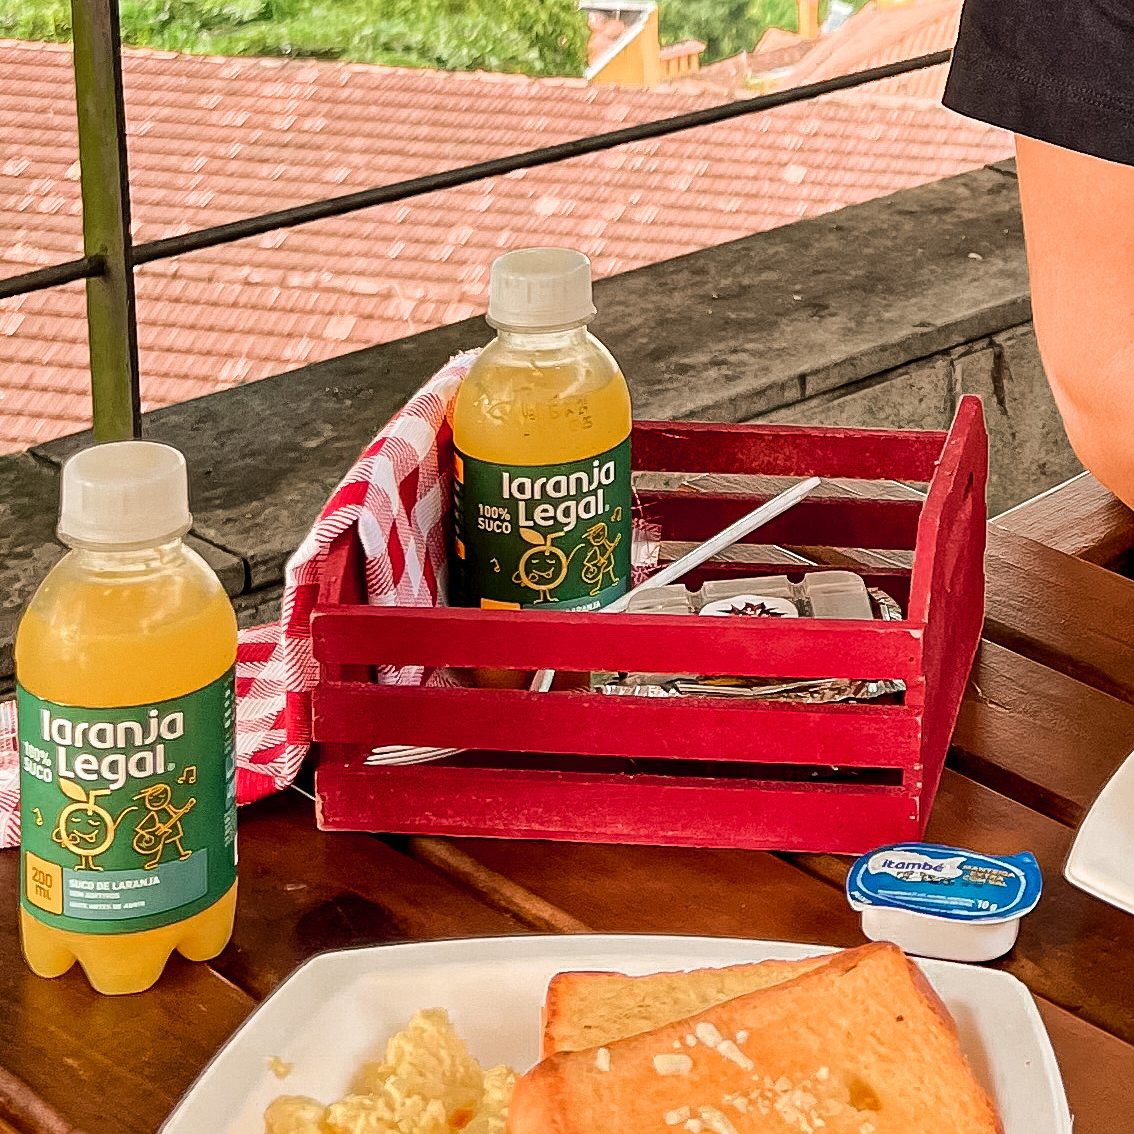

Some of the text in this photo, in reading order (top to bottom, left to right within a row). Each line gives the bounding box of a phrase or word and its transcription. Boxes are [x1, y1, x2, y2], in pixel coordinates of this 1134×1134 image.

[502, 460, 615, 500] laranja
[477, 503, 511, 521] 100%
[518, 488, 605, 532] Legal
[477, 518, 512, 534] SUCO
[41, 709, 184, 749] laranja
[23, 741, 52, 767] 100%
[23, 757, 53, 783] SUCO
[57, 744, 166, 791] Legal
[31, 866, 53, 889] 200
[882, 859, 944, 872] itambé
[68, 875, 161, 891] SUCO DE LARANJA
[976, 899, 990, 910] 10
